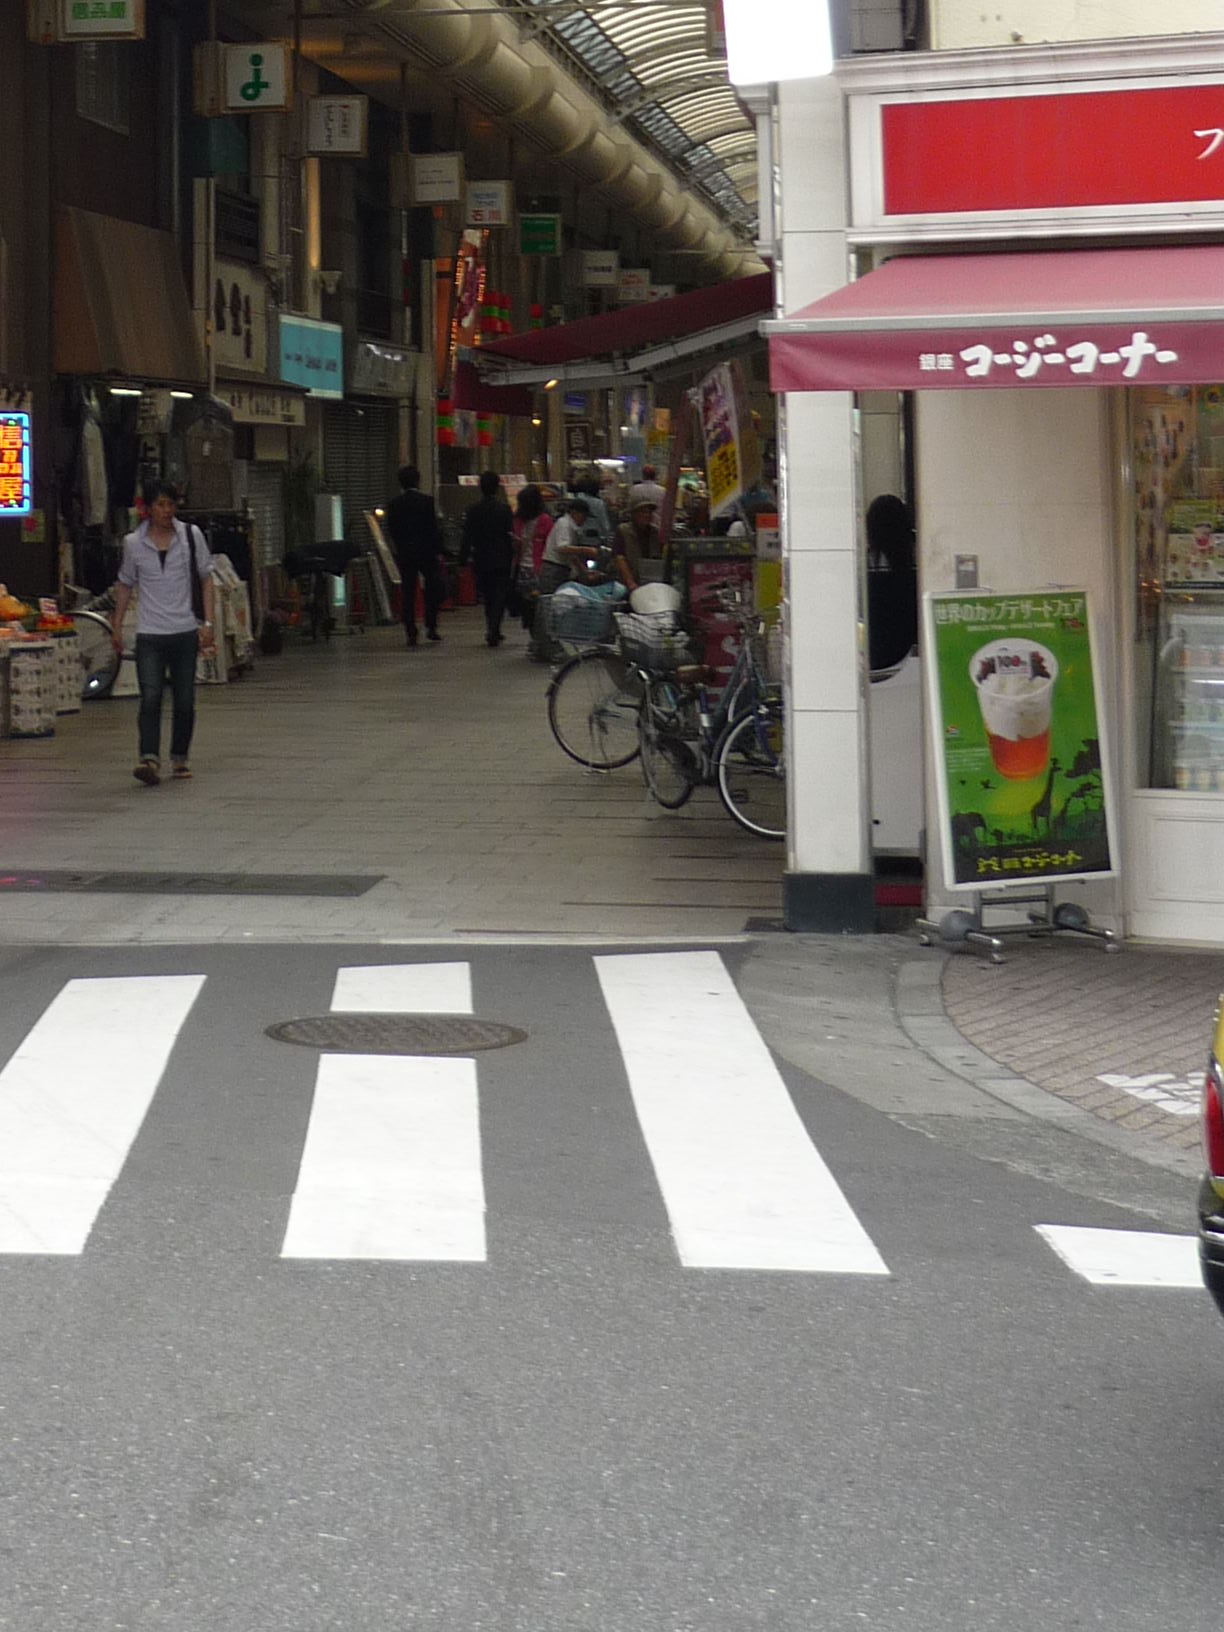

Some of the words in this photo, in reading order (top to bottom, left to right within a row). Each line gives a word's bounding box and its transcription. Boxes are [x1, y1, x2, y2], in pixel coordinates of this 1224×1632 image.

[919, 353, 955, 371] 銀座
[959, 331, 1179, 379] コージーコーナー
[935, 598, 1083, 625] 世界のカップデザートフェア
